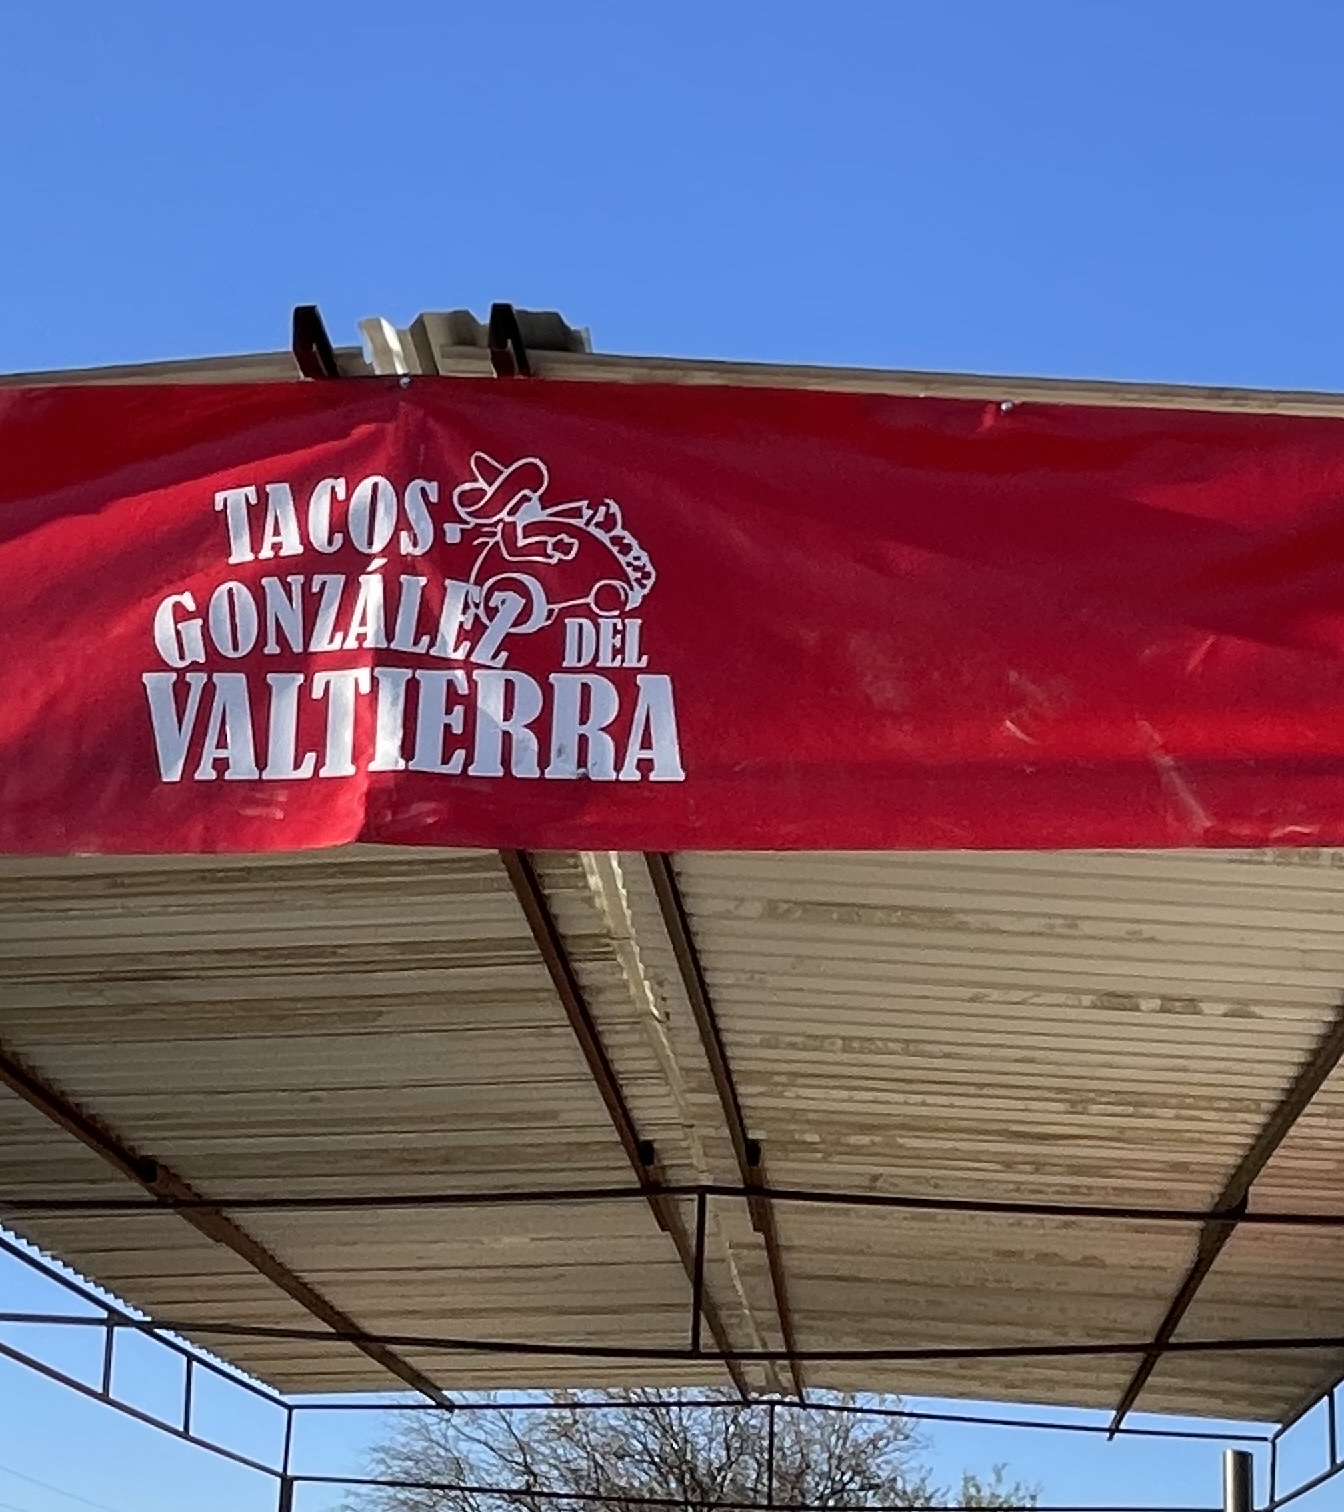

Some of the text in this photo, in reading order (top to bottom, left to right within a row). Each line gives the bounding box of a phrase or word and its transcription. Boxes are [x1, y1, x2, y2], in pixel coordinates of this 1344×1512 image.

[214, 475, 439, 565] TACOS
[154, 557, 649, 668] GONZÁLEZ DEL
[142, 666, 686, 783] VALTIERRA
